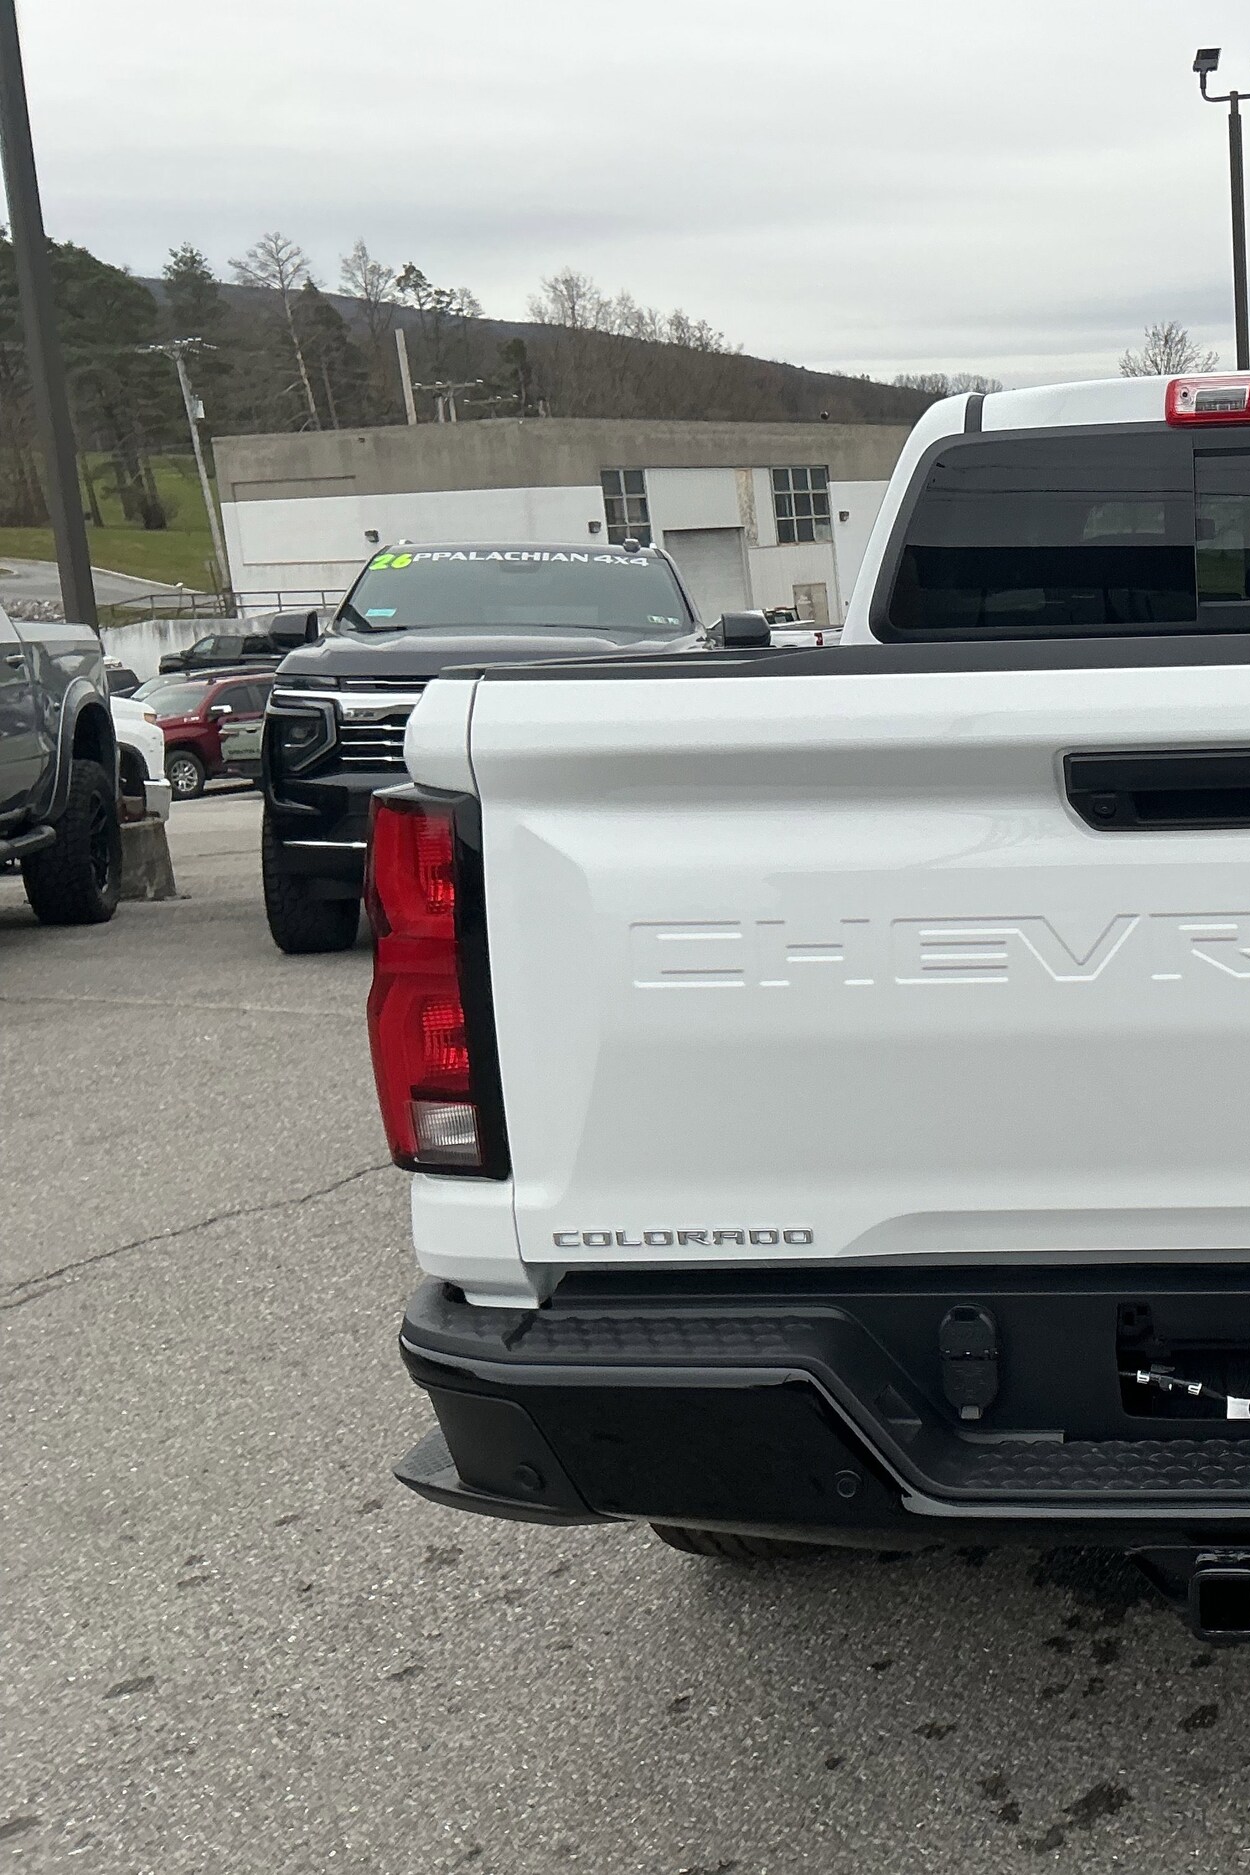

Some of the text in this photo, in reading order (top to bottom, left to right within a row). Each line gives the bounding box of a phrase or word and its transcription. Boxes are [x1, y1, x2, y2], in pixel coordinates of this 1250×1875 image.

[368, 553, 413, 570] 26
[412, 551, 588, 563] PPALACHIAN
[552, 1227, 815, 1247] COLORADO
